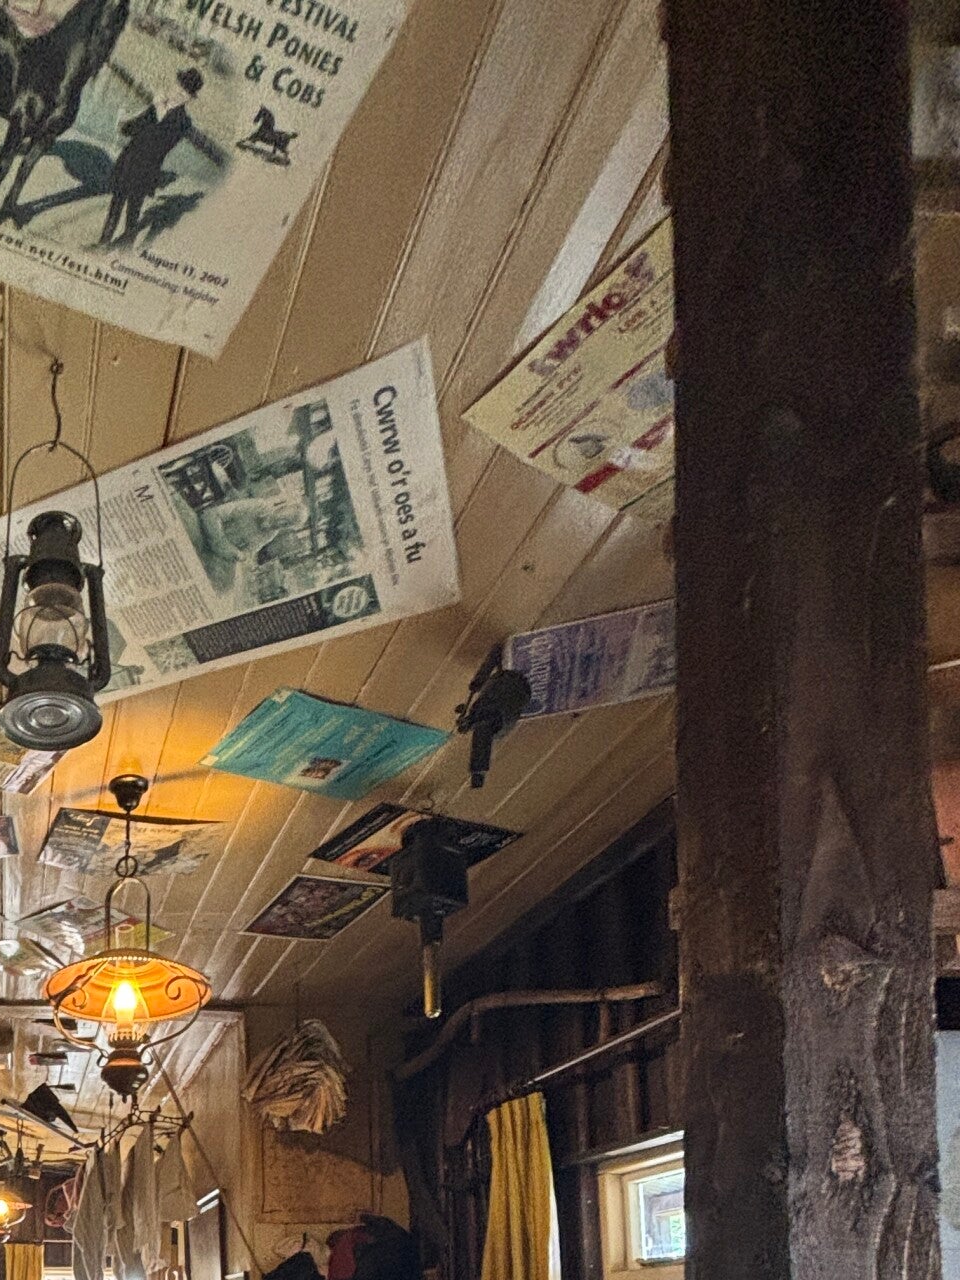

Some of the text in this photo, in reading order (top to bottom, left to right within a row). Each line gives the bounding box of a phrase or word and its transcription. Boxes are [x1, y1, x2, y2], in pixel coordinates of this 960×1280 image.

[266, 0, 358, 43] ESTIVAL
[266, 21, 343, 76] PONIES
[244, 55, 326, 109] & COBS
[139, 249, 178, 273] August
[200, 271, 229, 288] 2002
[373, 385, 402, 456] Cwrw
[388, 459, 411, 488] o'r
[394, 490, 416, 527] oes
[401, 528, 419, 542] a
[405, 541, 426, 564] fu
